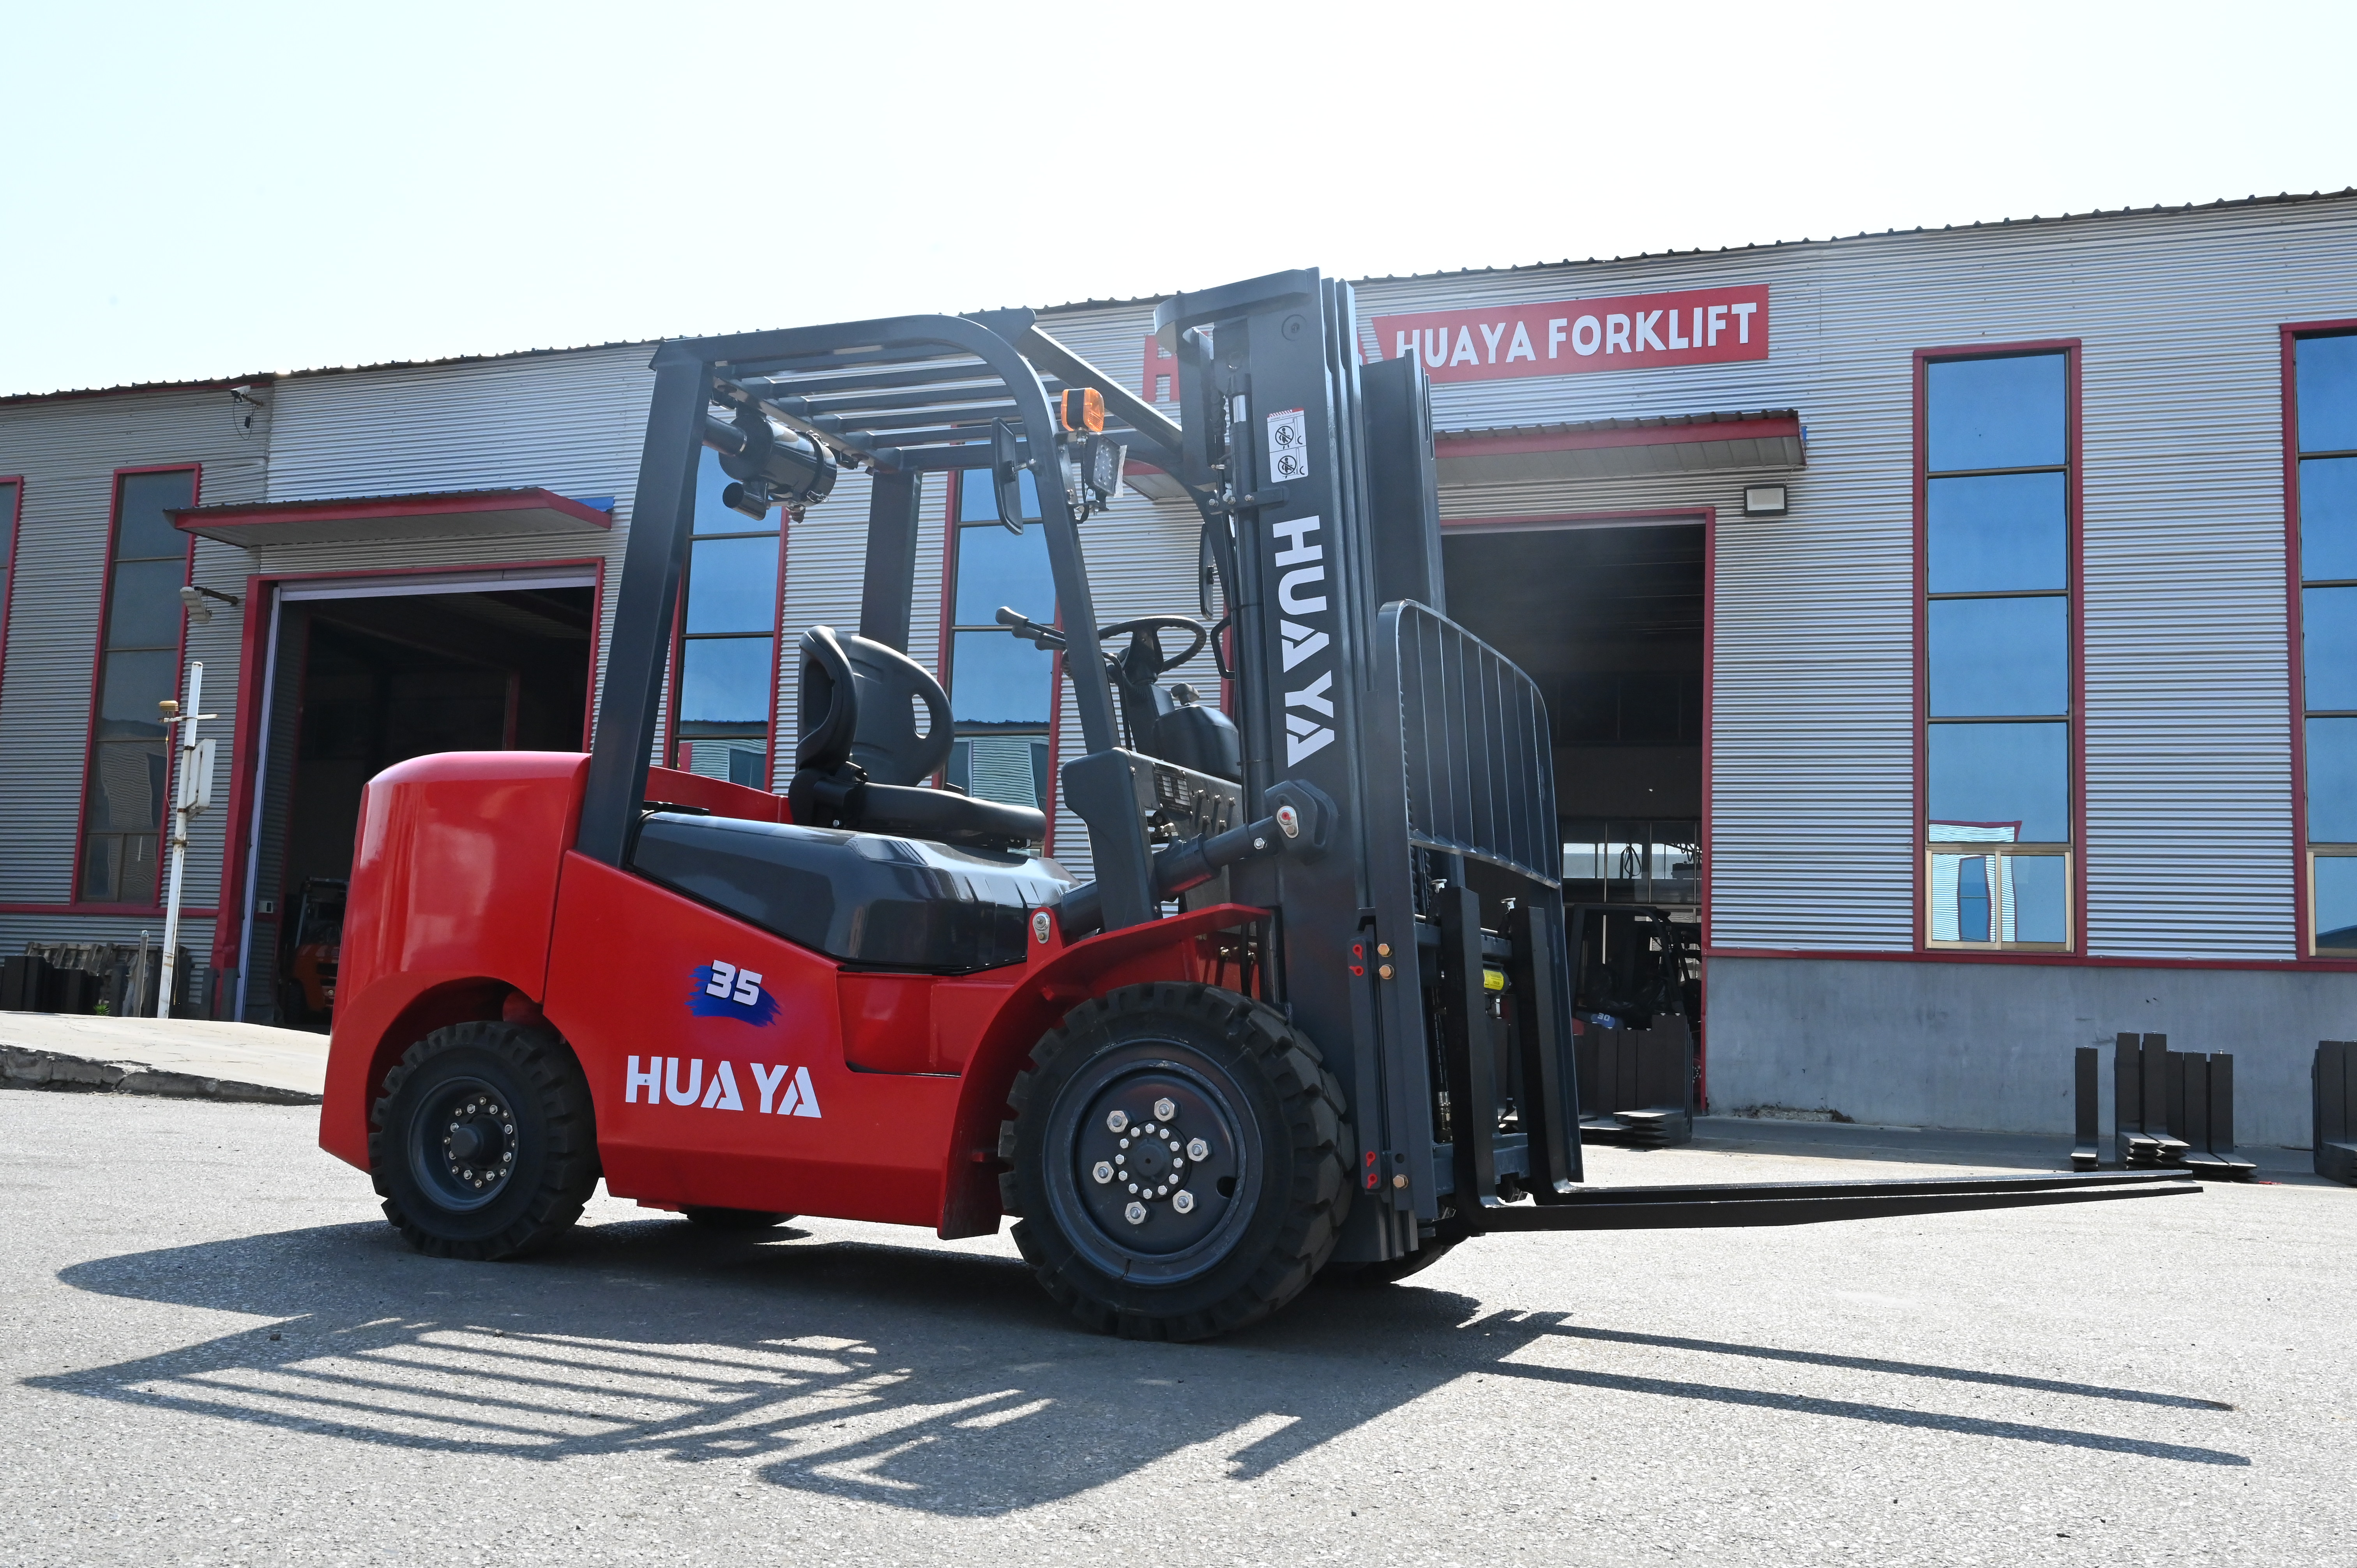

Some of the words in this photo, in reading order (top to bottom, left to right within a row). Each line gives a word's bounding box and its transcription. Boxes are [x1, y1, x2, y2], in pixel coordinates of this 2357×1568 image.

[1396, 321, 1536, 368] HUAYA
[1548, 302, 1757, 359] FORKLIFT
[1272, 515, 1335, 768] HUAYA
[706, 959, 763, 1006] 35
[1597, 1012, 1611, 1022] 30
[625, 1055, 822, 1118] HUAYA
